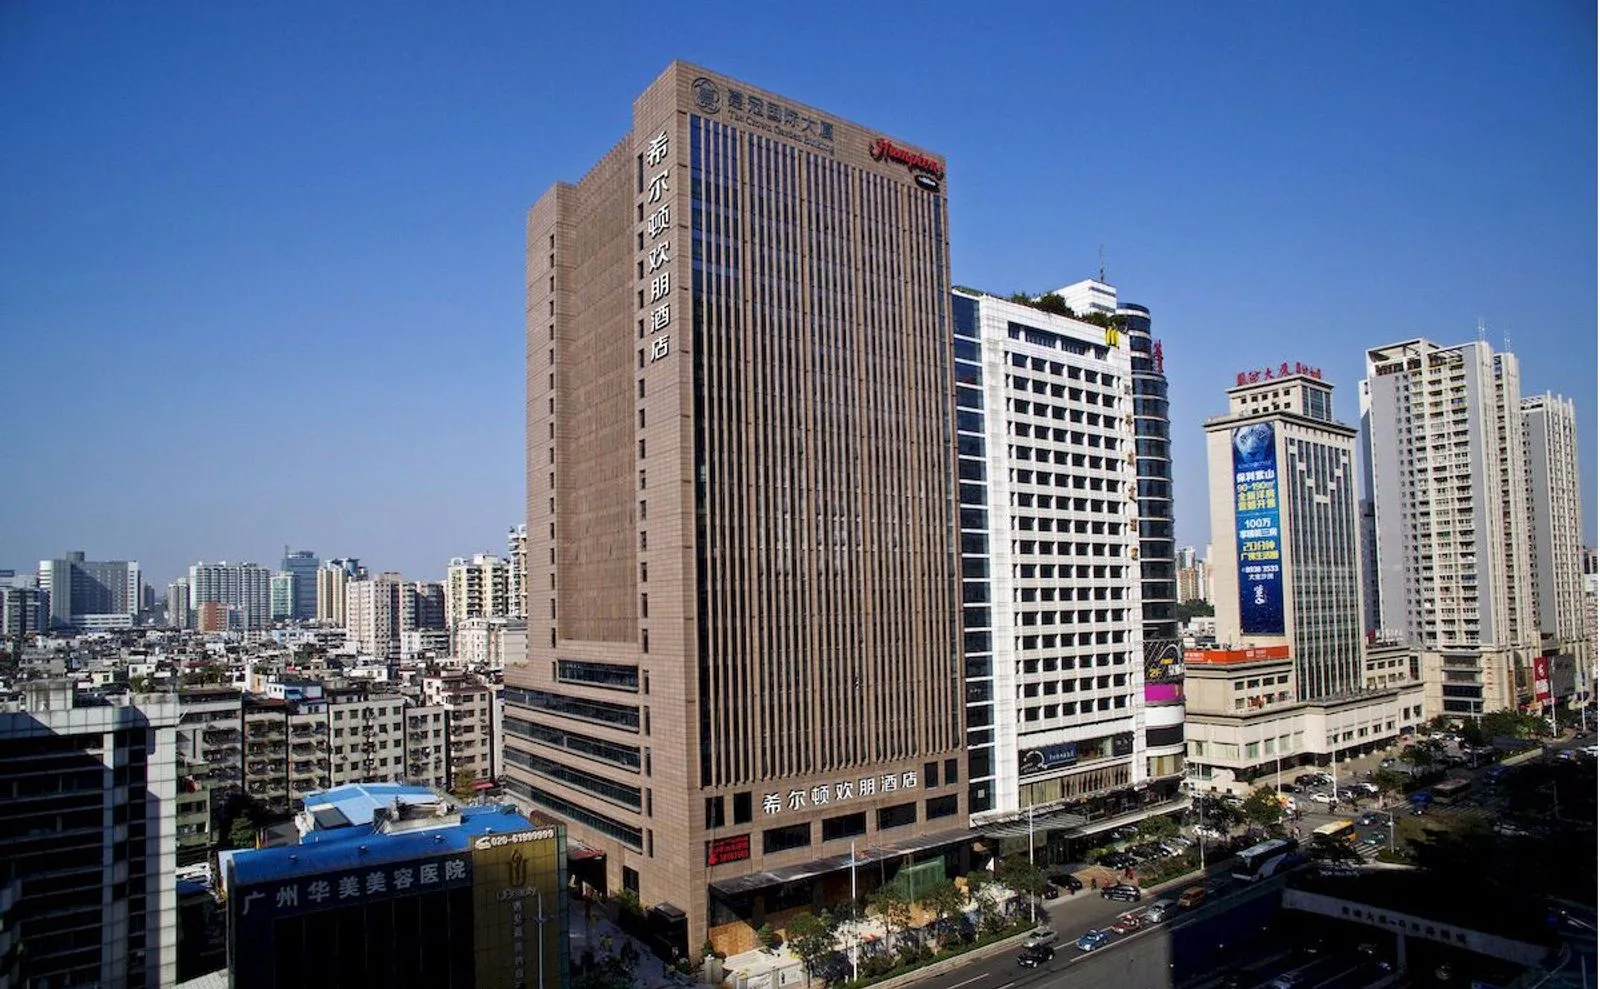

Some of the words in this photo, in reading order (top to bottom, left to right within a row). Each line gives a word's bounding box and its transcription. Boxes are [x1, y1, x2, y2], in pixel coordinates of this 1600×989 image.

[869, 138, 945, 181] Hampton
[646, 131, 671, 362] 希尔顿欢朋酒店
[762, 770, 918, 814] 希尔顿欢朋酒店
[241, 858, 470, 916] 广州华美美容医院
